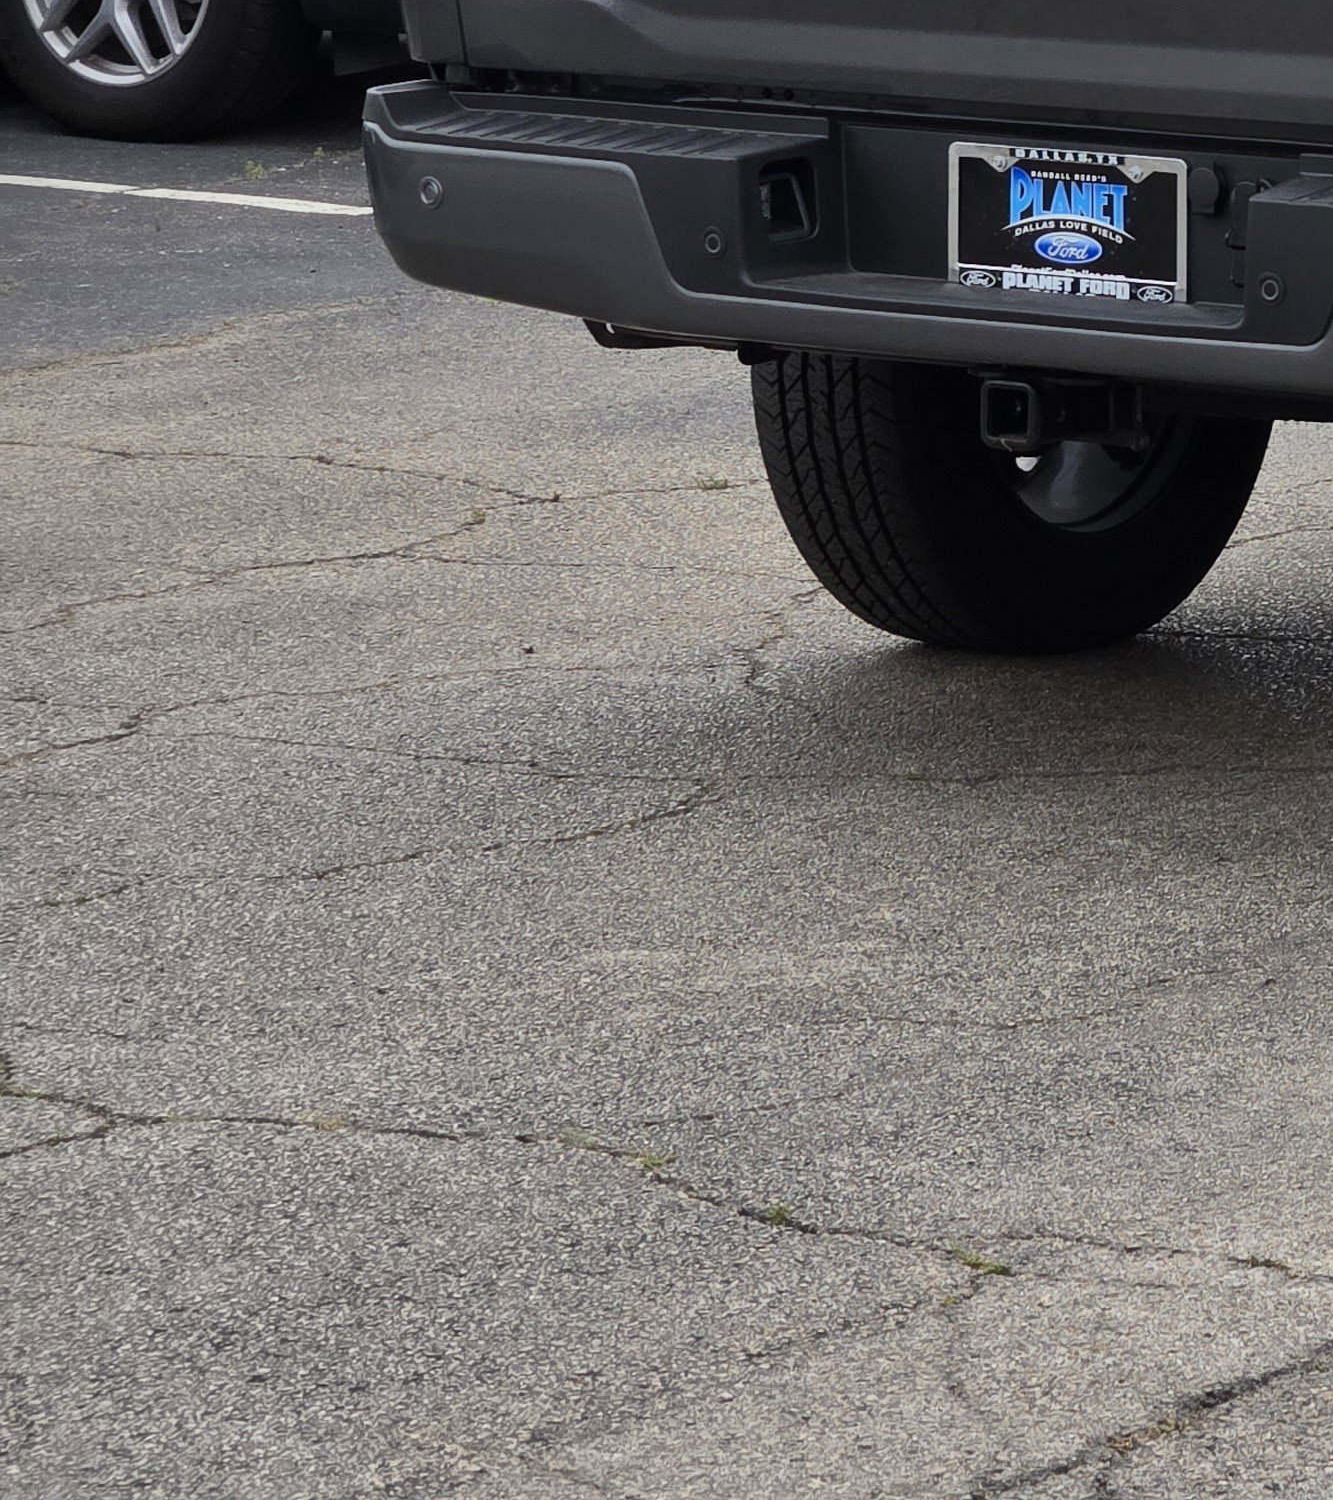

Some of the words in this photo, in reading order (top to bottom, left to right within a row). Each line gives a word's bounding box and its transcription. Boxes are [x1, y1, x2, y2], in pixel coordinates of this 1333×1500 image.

[1010, 166, 1128, 232] PLANET
[1014, 220, 1056, 237] DALLAS
[1060, 221, 1088, 232] LOVE
[1091, 225, 1123, 244] FIELD
[1047, 238, 1089, 260] Ford
[1002, 271, 1074, 293] PLANET
[1079, 279, 1130, 300] FORD
